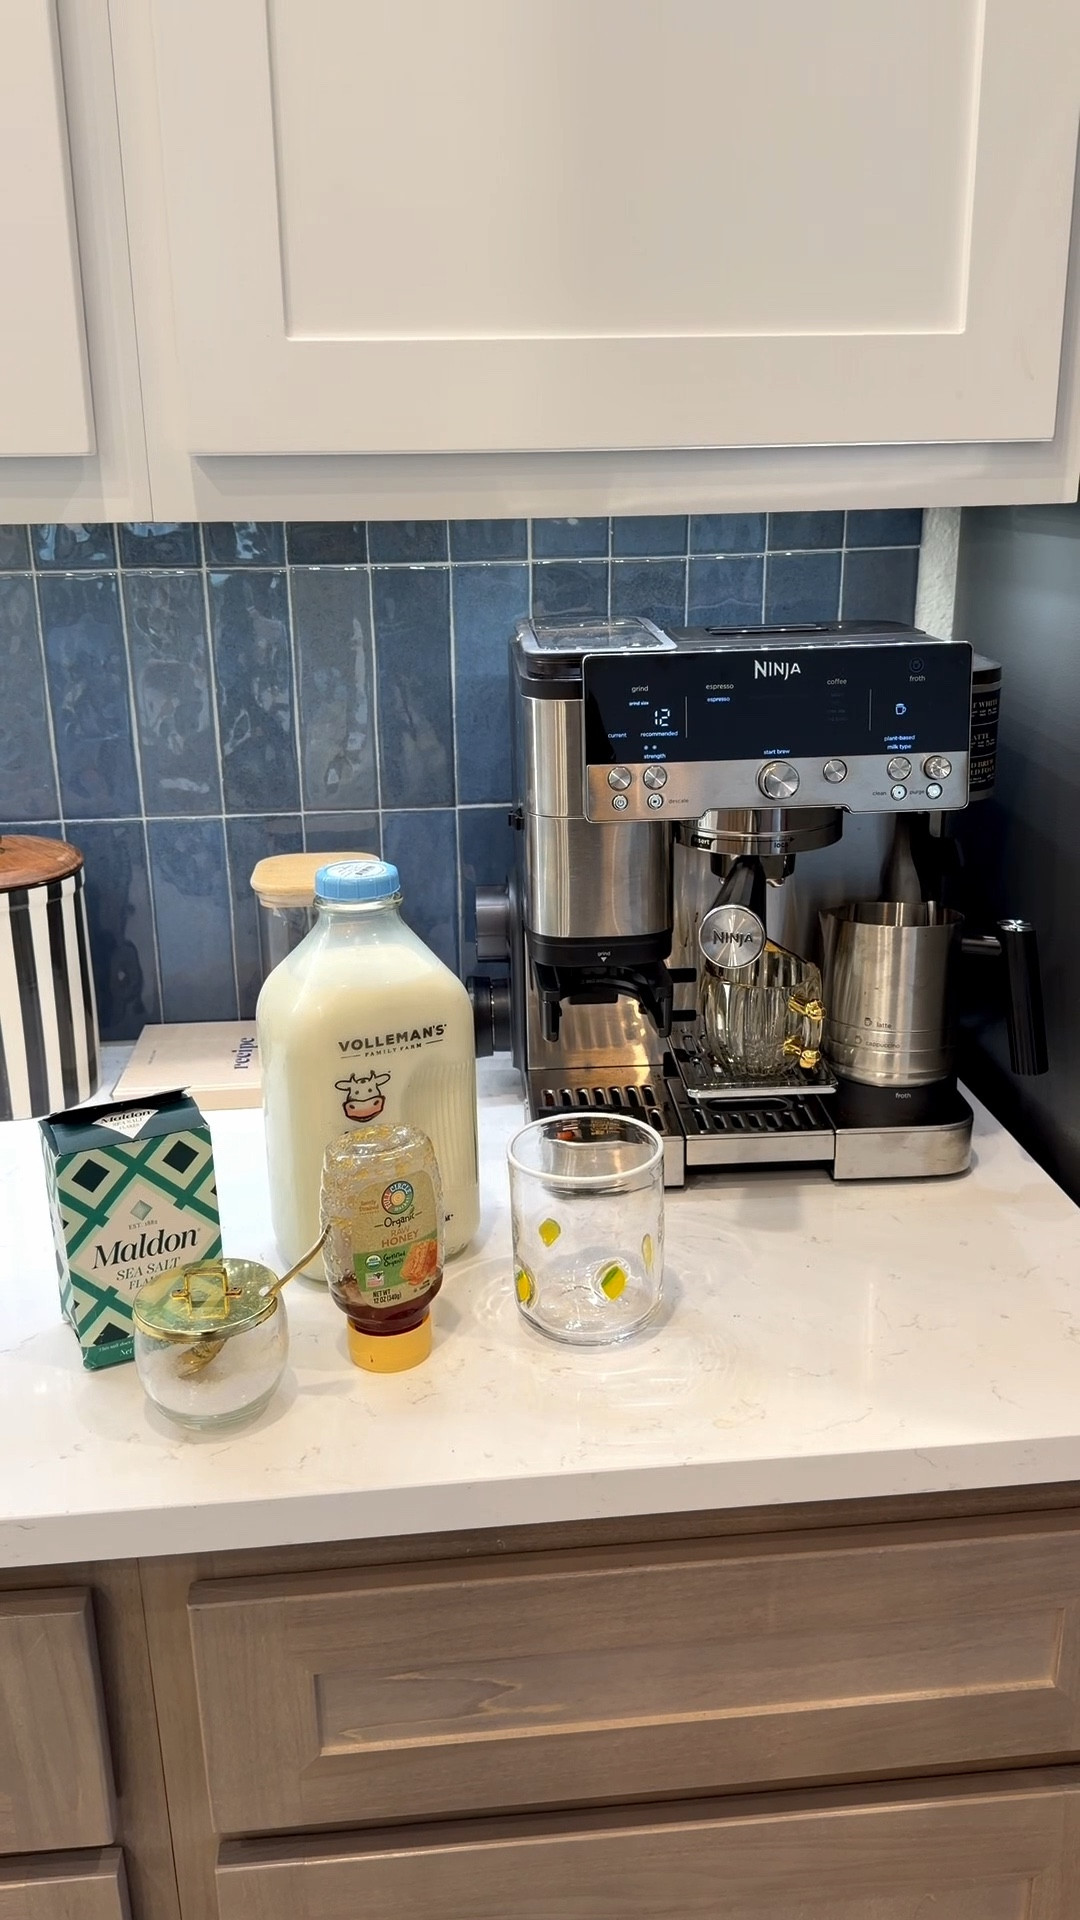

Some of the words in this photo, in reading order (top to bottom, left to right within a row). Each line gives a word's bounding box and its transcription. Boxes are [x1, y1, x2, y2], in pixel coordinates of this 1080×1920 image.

[754, 660, 801, 680] NINJA
[826, 678, 848, 686] coffee
[909, 675, 926, 683] froth
[631, 685, 649, 693] grind
[705, 683, 735, 691] espresso
[654, 708, 671, 727] 12
[899, 743, 912, 751] type
[909, 788, 925, 796] purge
[697, 838, 711, 846] sert
[713, 931, 753, 947] NINJA
[338, 1024, 445, 1052] VOLLEMAN'S
[234, 1037, 258, 1069] recipe
[365, 1047, 397, 1057] FAMILY
[400, 1043, 422, 1051] FARM
[101, 1110, 152, 1124] Maldon
[383, 1192, 392, 1210] FULL
[390, 1183, 412, 1194] CIRCLE
[383, 1211, 415, 1228] Organic
[390, 1226, 410, 1237] RAW
[381, 1230, 419, 1248] HONEY
[92, 1228, 197, 1270] Maldon
[116, 1264, 142, 1281] SEA
[147, 1257, 181, 1274] SALT
[128, 1276, 155, 1290] FLA
[372, 1290, 384, 1298] NET
[379, 1295, 387, 1303] OZ
